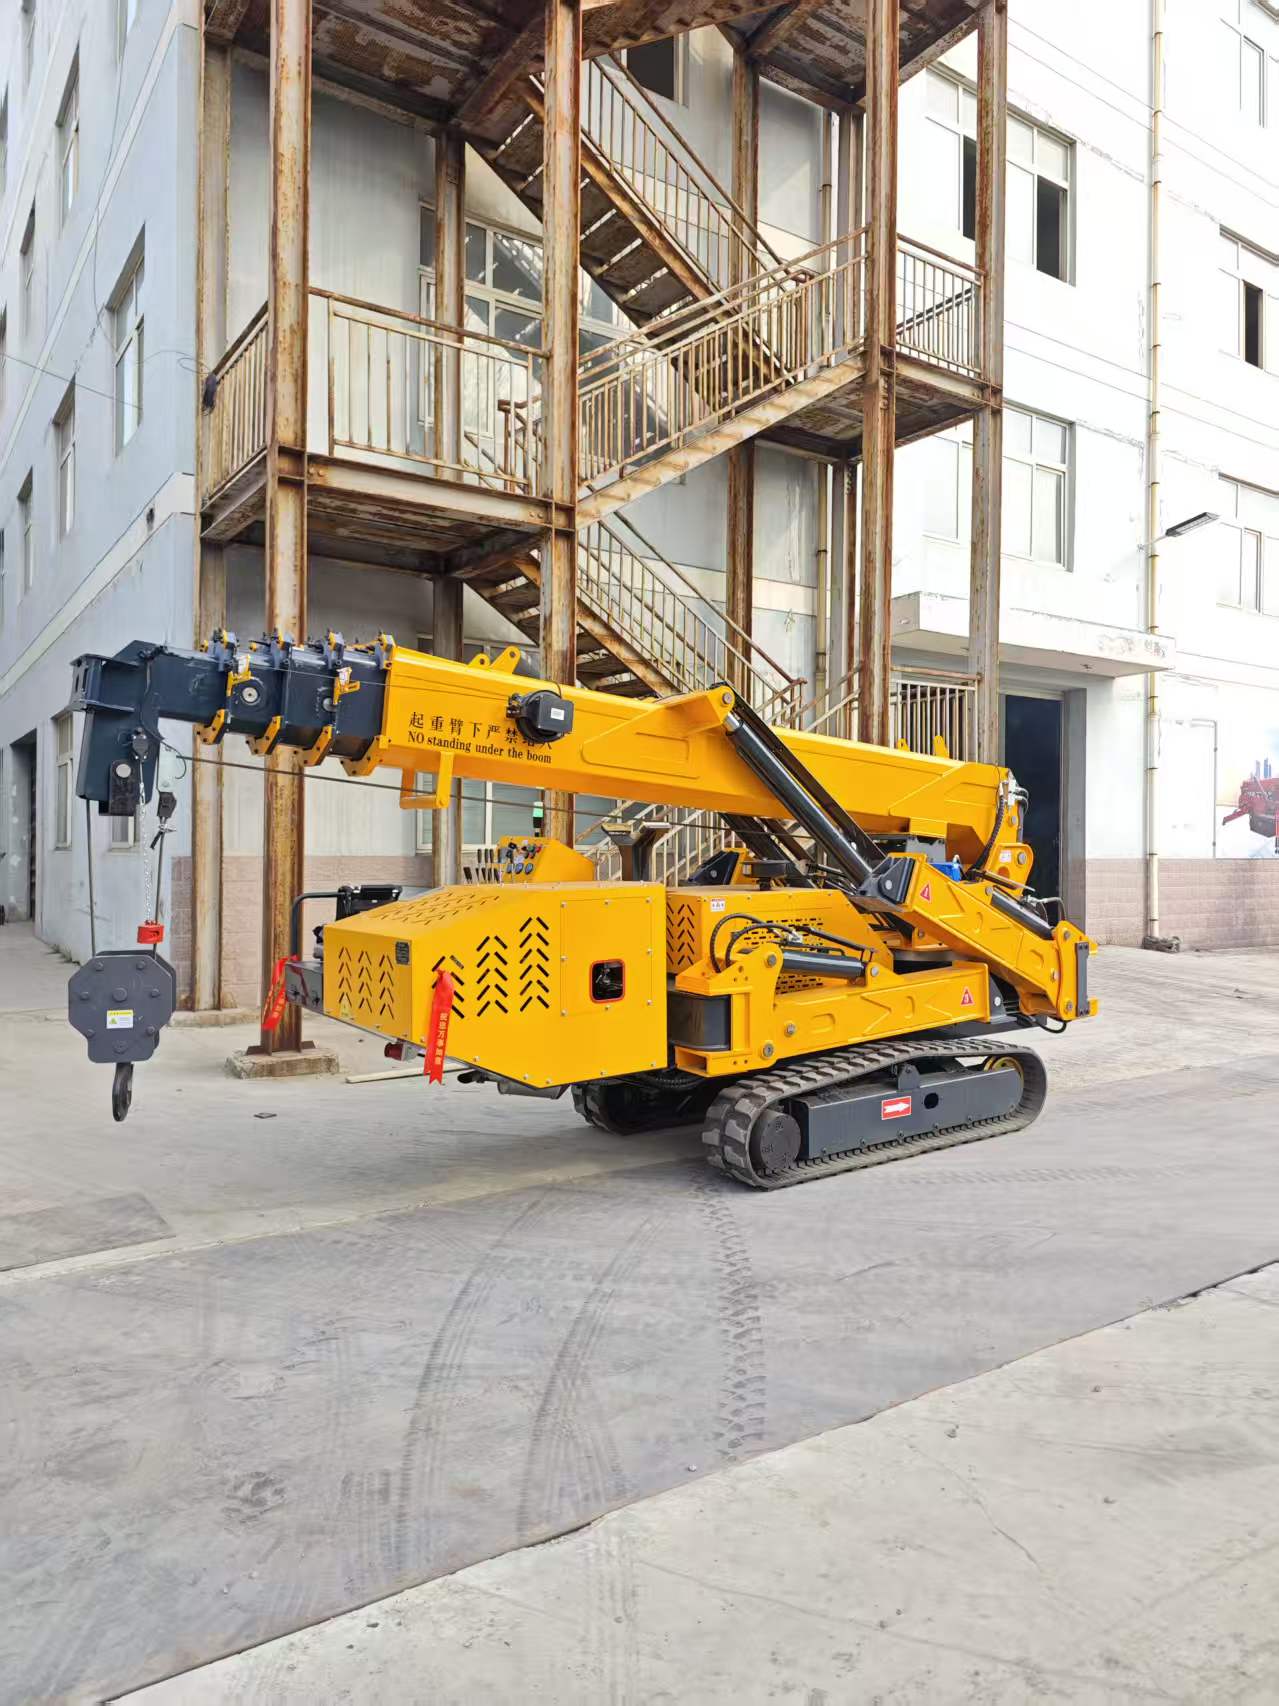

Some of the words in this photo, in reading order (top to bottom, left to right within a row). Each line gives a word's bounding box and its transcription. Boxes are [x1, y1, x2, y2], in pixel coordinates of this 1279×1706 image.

[408, 730, 425, 744] NO
[427, 737, 472, 753] standing
[475, 744, 504, 756] under
[508, 747, 523, 759] the
[526, 749, 552, 764] boom
